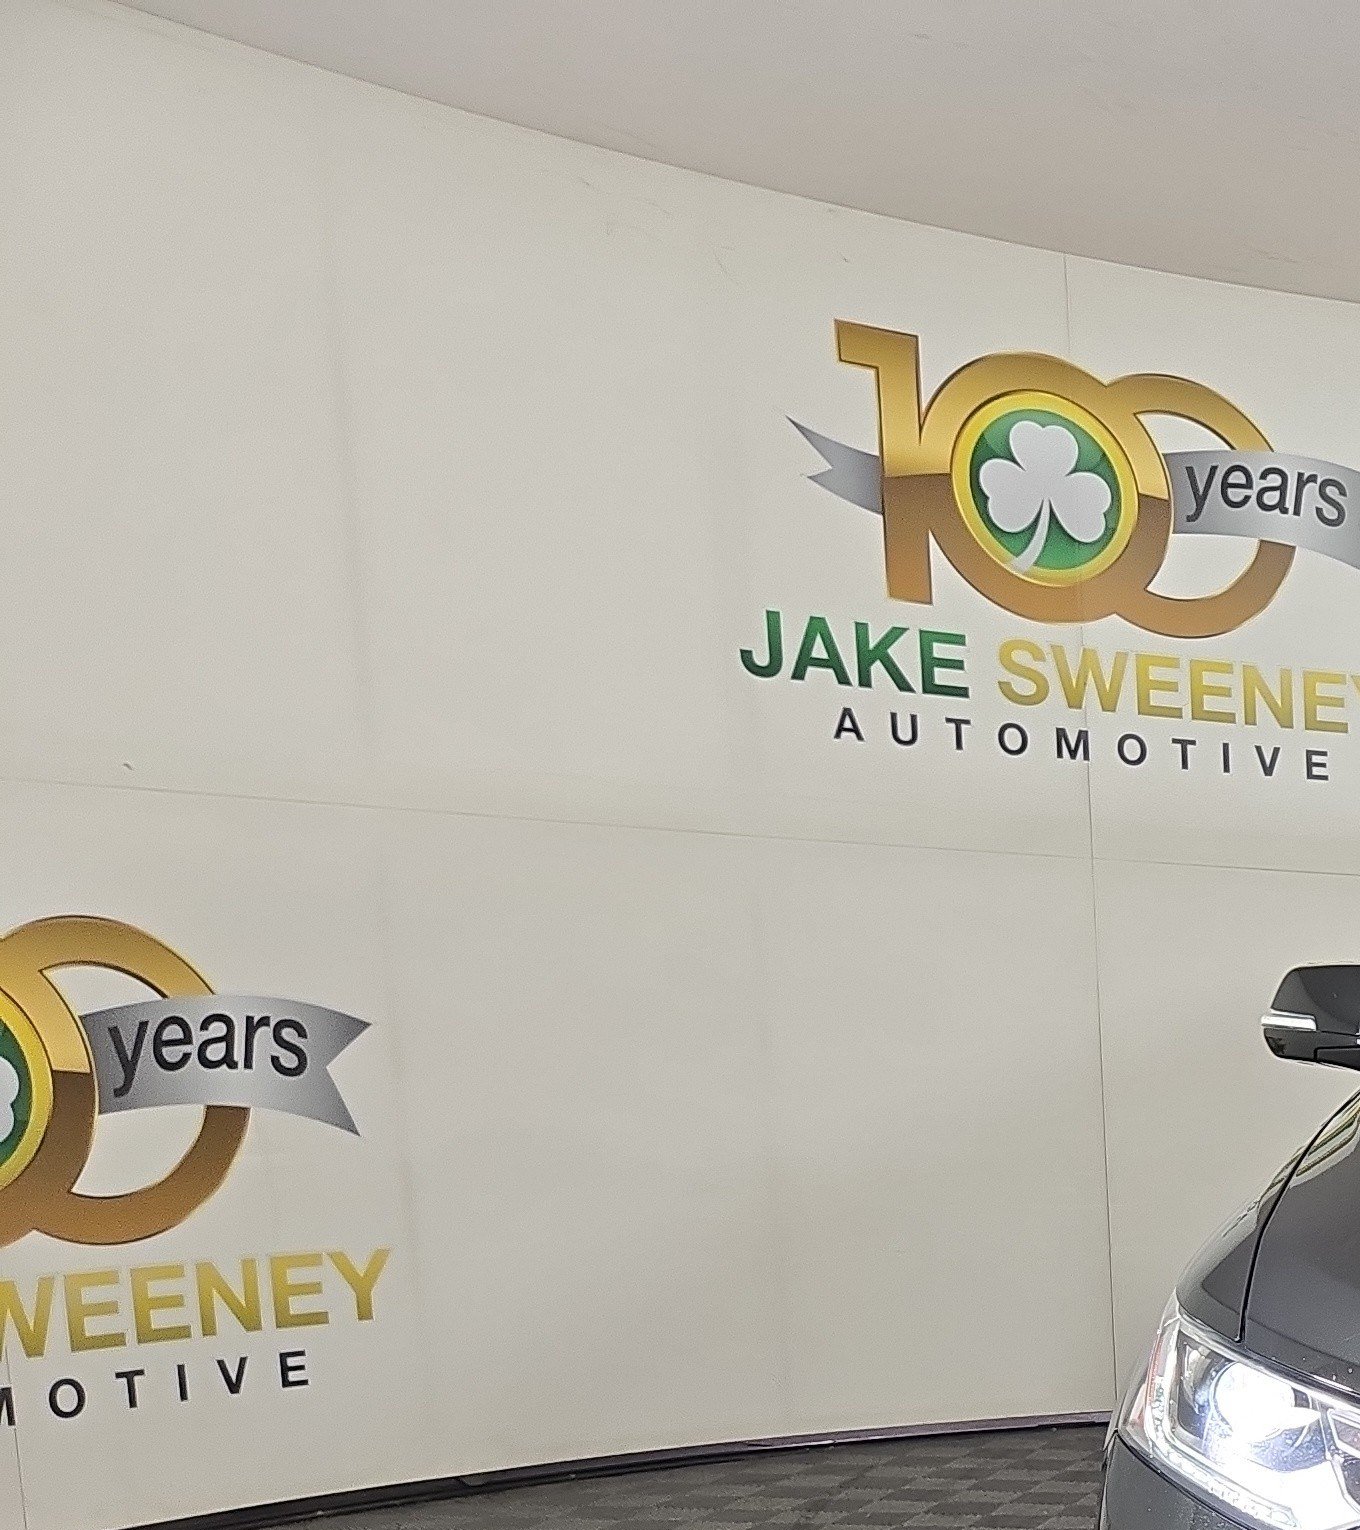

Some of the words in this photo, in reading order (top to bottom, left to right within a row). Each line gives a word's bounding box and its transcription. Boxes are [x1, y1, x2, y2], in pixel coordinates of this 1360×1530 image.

[1185, 464, 1347, 528] years
[739, 610, 971, 699] JAKE
[832, 707, 1330, 782] AUTOMOTIVE
[107, 1012, 309, 1098] years
